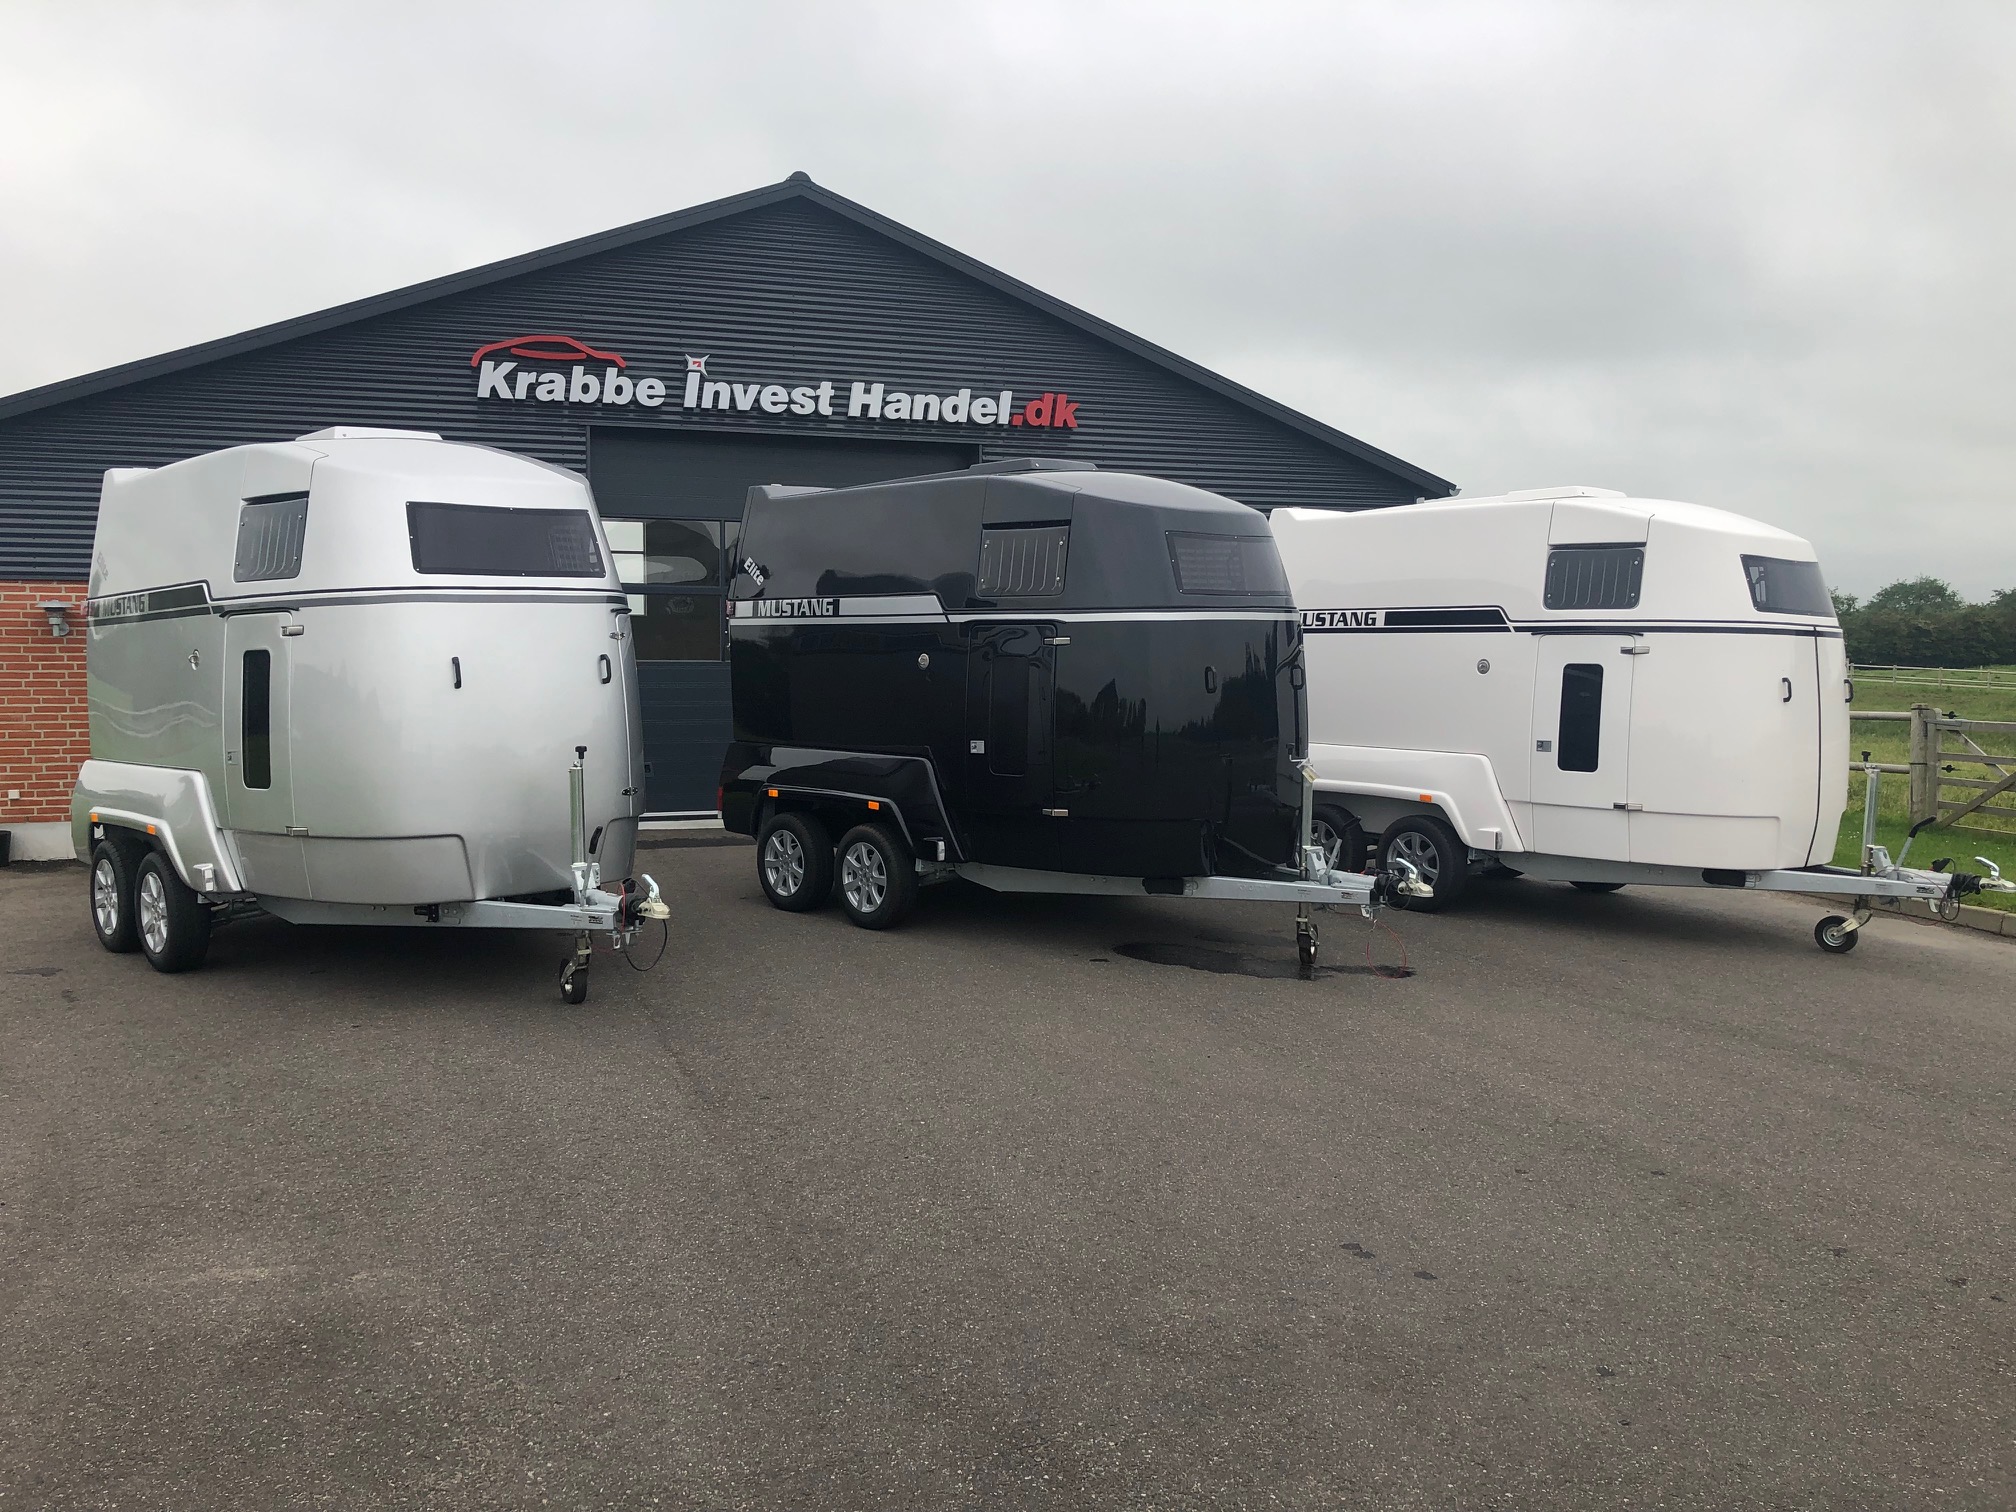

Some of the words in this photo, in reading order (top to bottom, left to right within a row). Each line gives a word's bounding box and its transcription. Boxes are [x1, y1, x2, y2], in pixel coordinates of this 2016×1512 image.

[477, 360, 667, 407] Krabbe
[683, 370, 836, 416] Invest
[848, 381, 1081, 429] Handel.dk
[743, 556, 765, 586] Elite
[102, 594, 146, 617] MUSTANG
[757, 599, 834, 617] MUSTANG
[1300, 611, 1377, 627] USTANG
